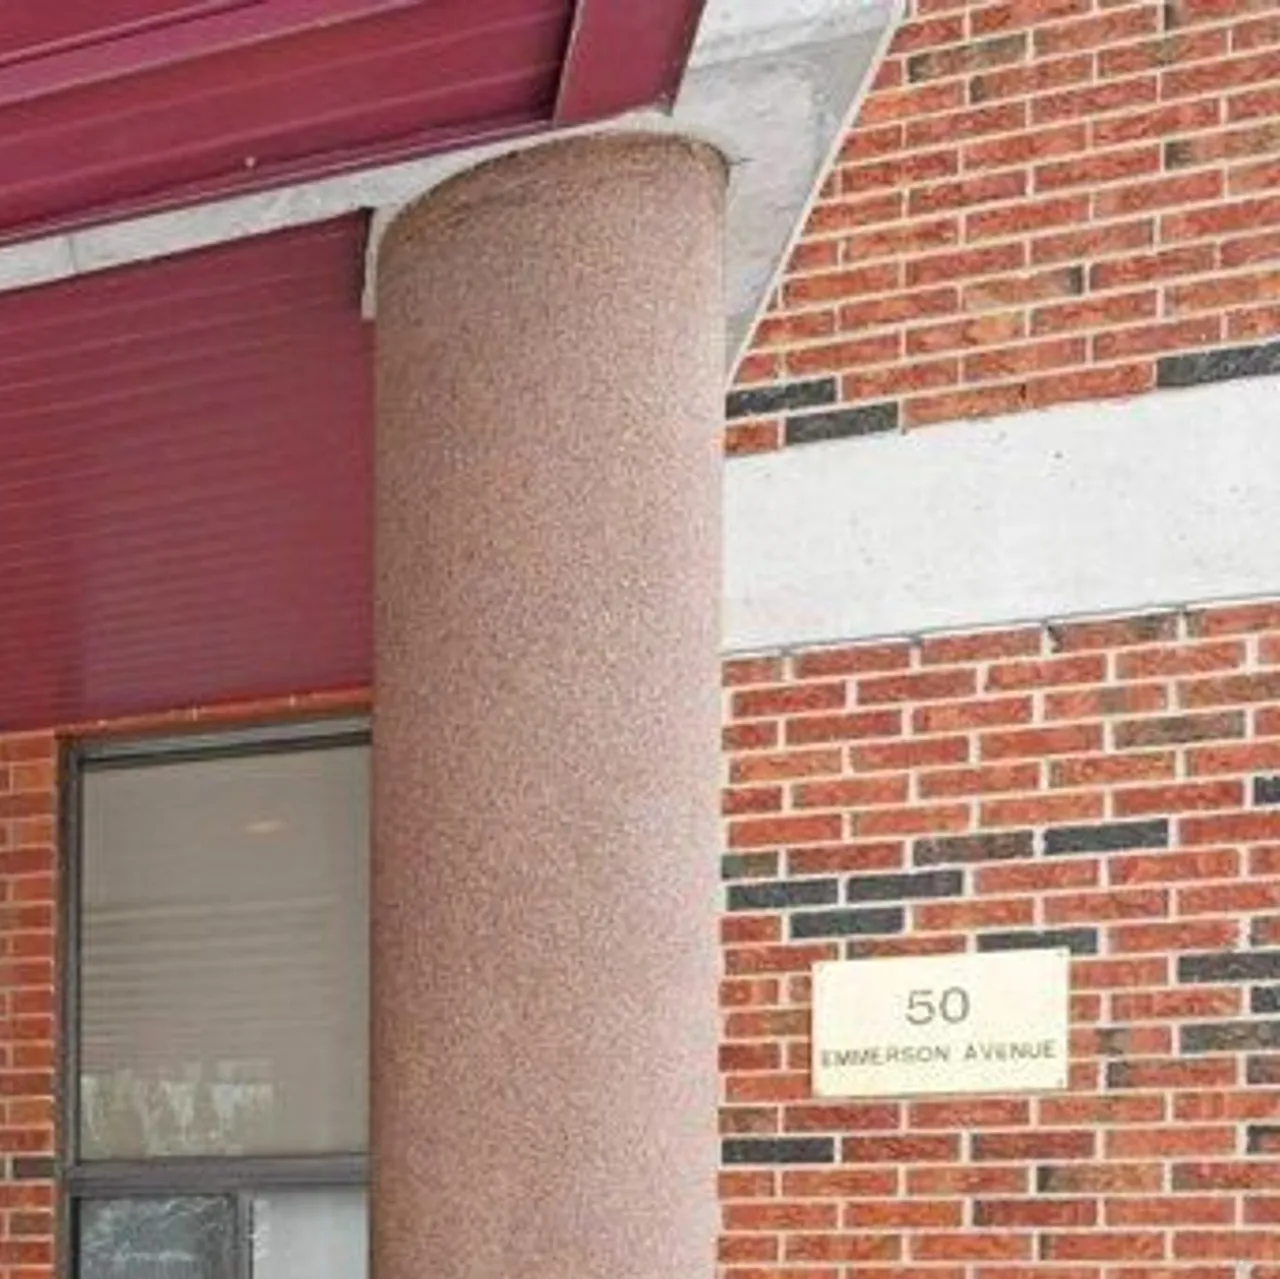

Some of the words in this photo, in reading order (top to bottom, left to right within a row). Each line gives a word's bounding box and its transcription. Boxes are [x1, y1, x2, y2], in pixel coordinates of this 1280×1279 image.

[904, 986, 971, 1026] 50
[820, 1045, 951, 1068] EMMERSON
[963, 1039, 1058, 1061] AVENUE
